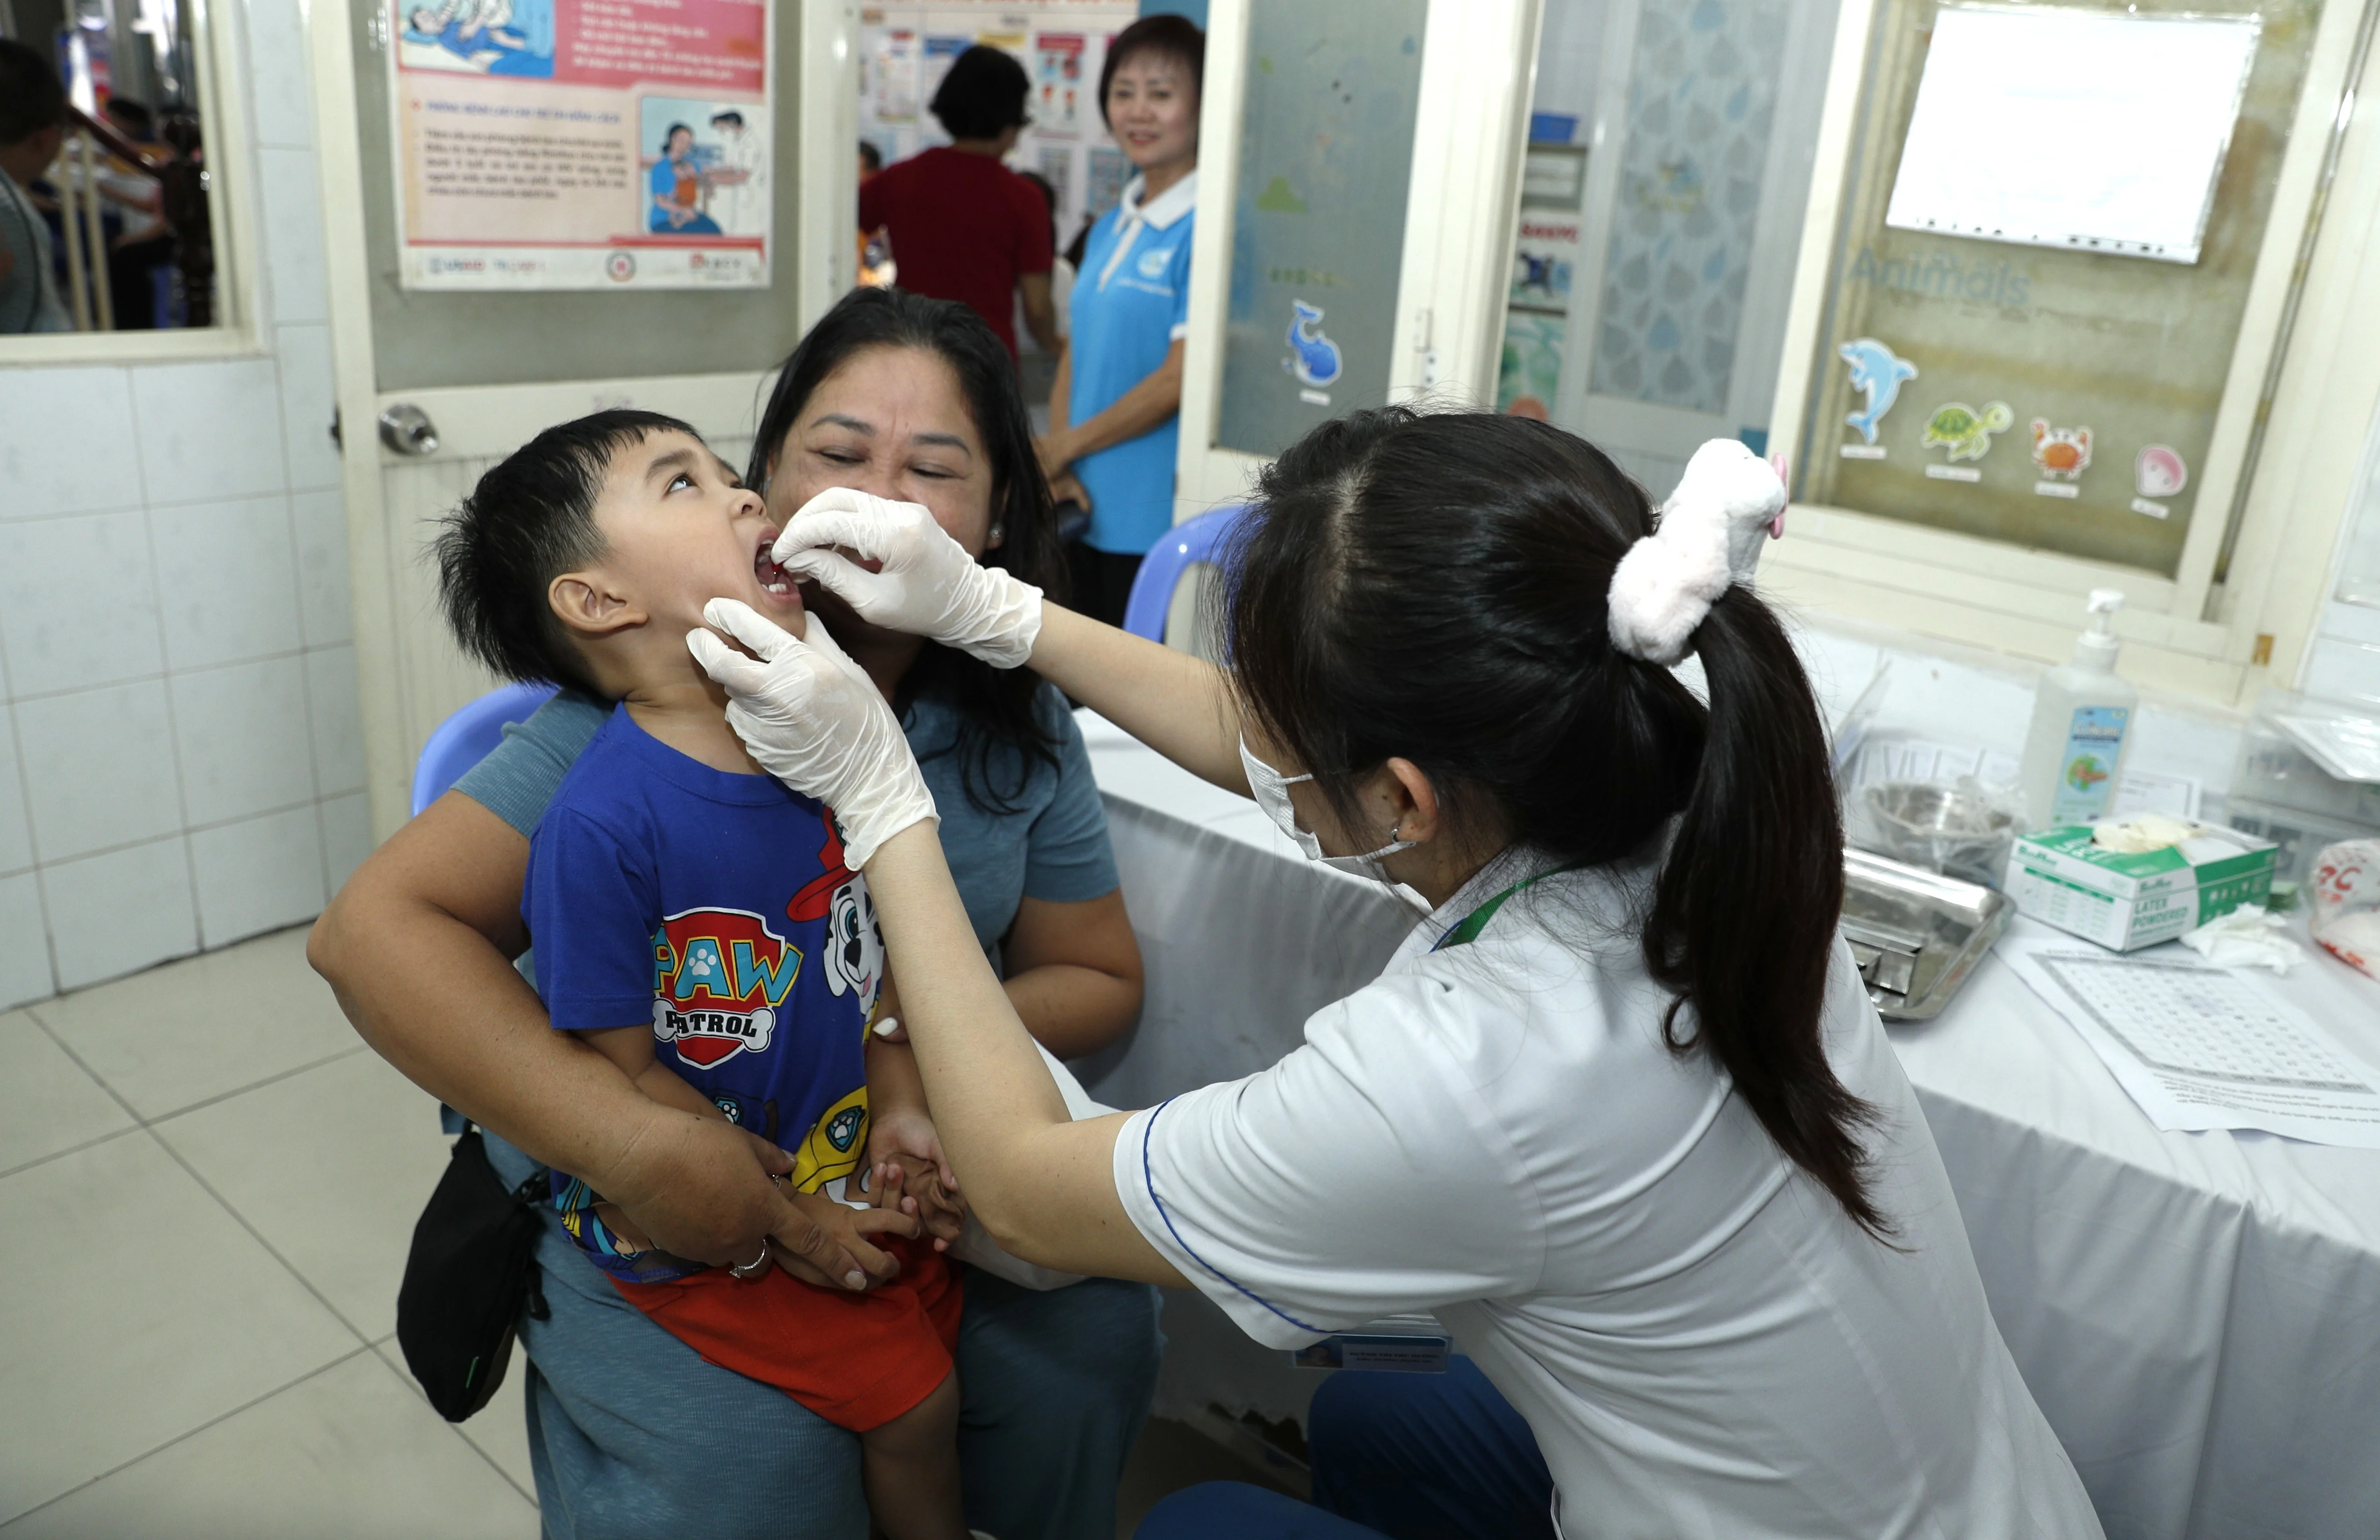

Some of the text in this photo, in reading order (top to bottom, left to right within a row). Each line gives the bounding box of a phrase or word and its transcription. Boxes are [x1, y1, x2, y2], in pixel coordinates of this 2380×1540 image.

[1849, 245, 2031, 305] Animals
[2131, 906, 2189, 929] POWDERED
[2134, 897, 2168, 915] LATEX
[651, 923, 804, 1006] PAW
[665, 1011, 758, 1038] PATROL
